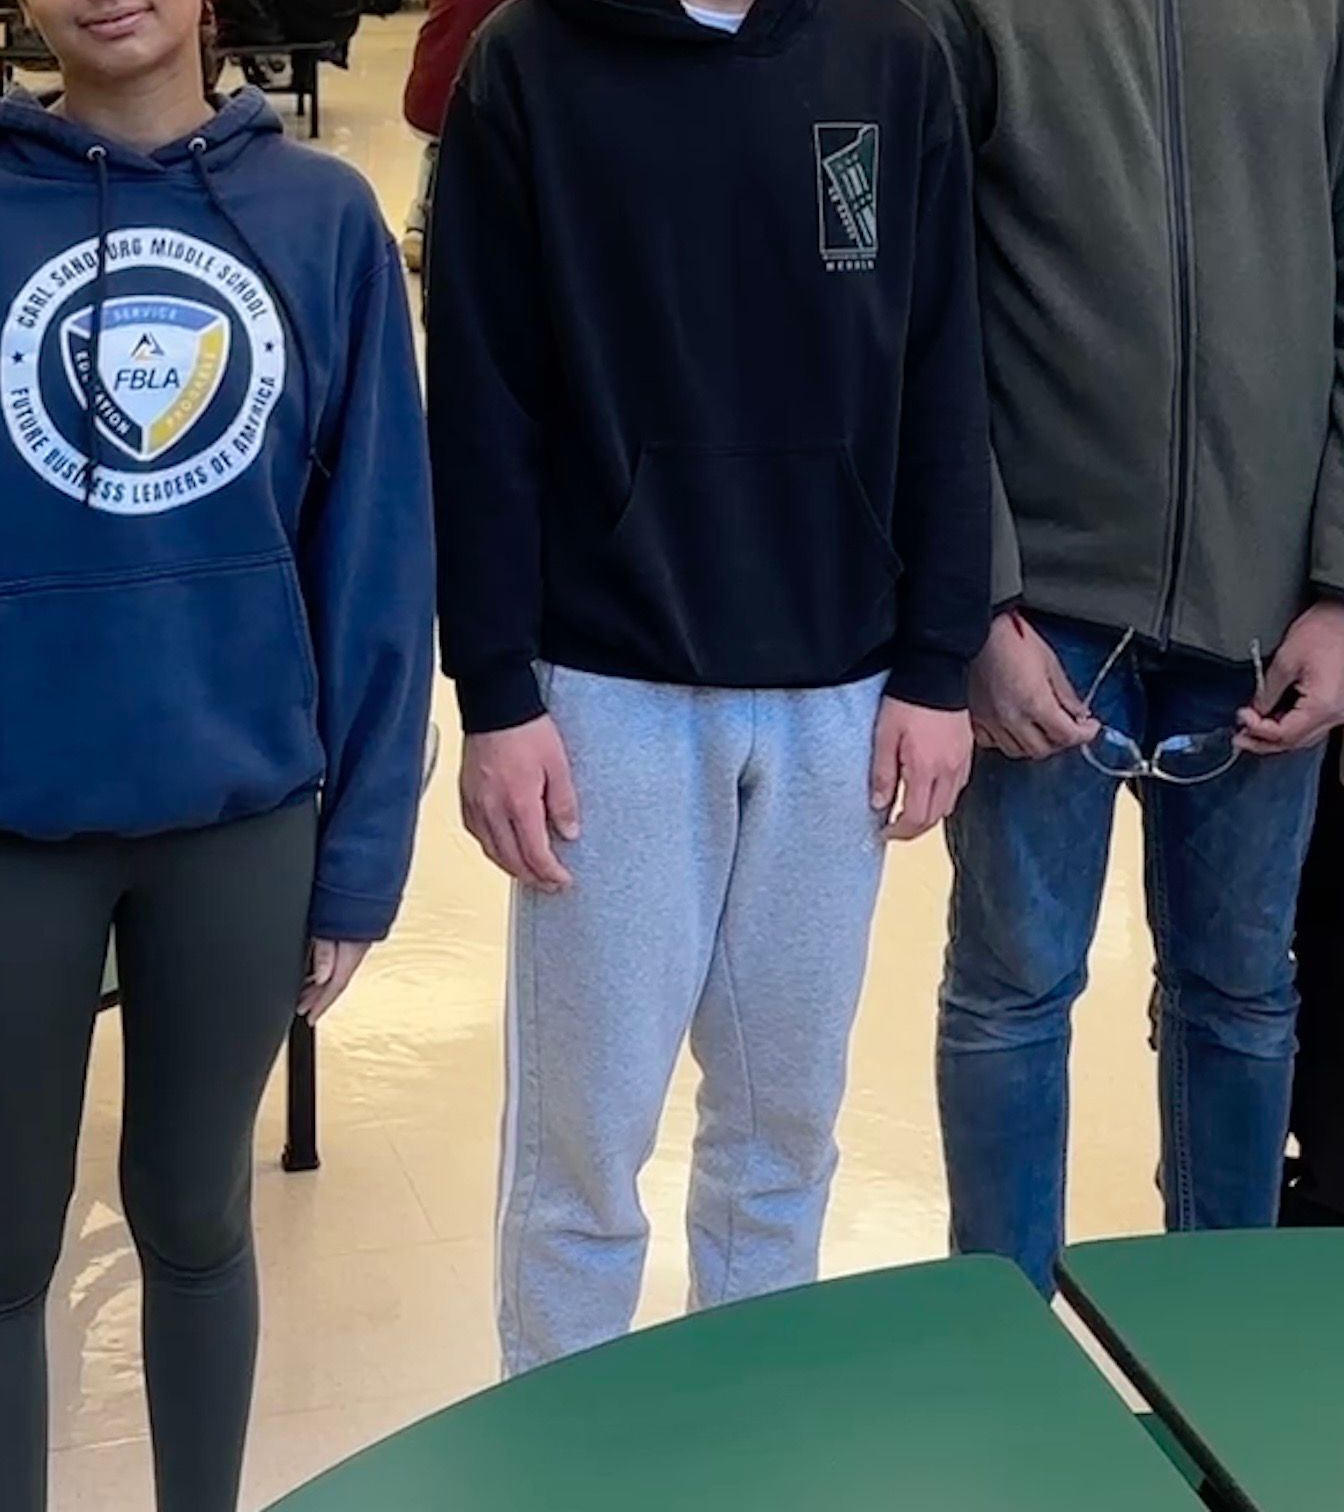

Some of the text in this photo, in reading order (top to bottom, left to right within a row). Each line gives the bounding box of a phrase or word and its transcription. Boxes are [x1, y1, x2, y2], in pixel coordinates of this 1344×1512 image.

[16, 237, 268, 329] CARL SANDURG MIDDLE SCHOOL
[113, 366, 181, 392] FBLA
[10, 386, 51, 453] FUTURE
[132, 464, 209, 504] LEADERS
[209, 449, 234, 476] OF
[231, 375, 277, 456] AMERICA
